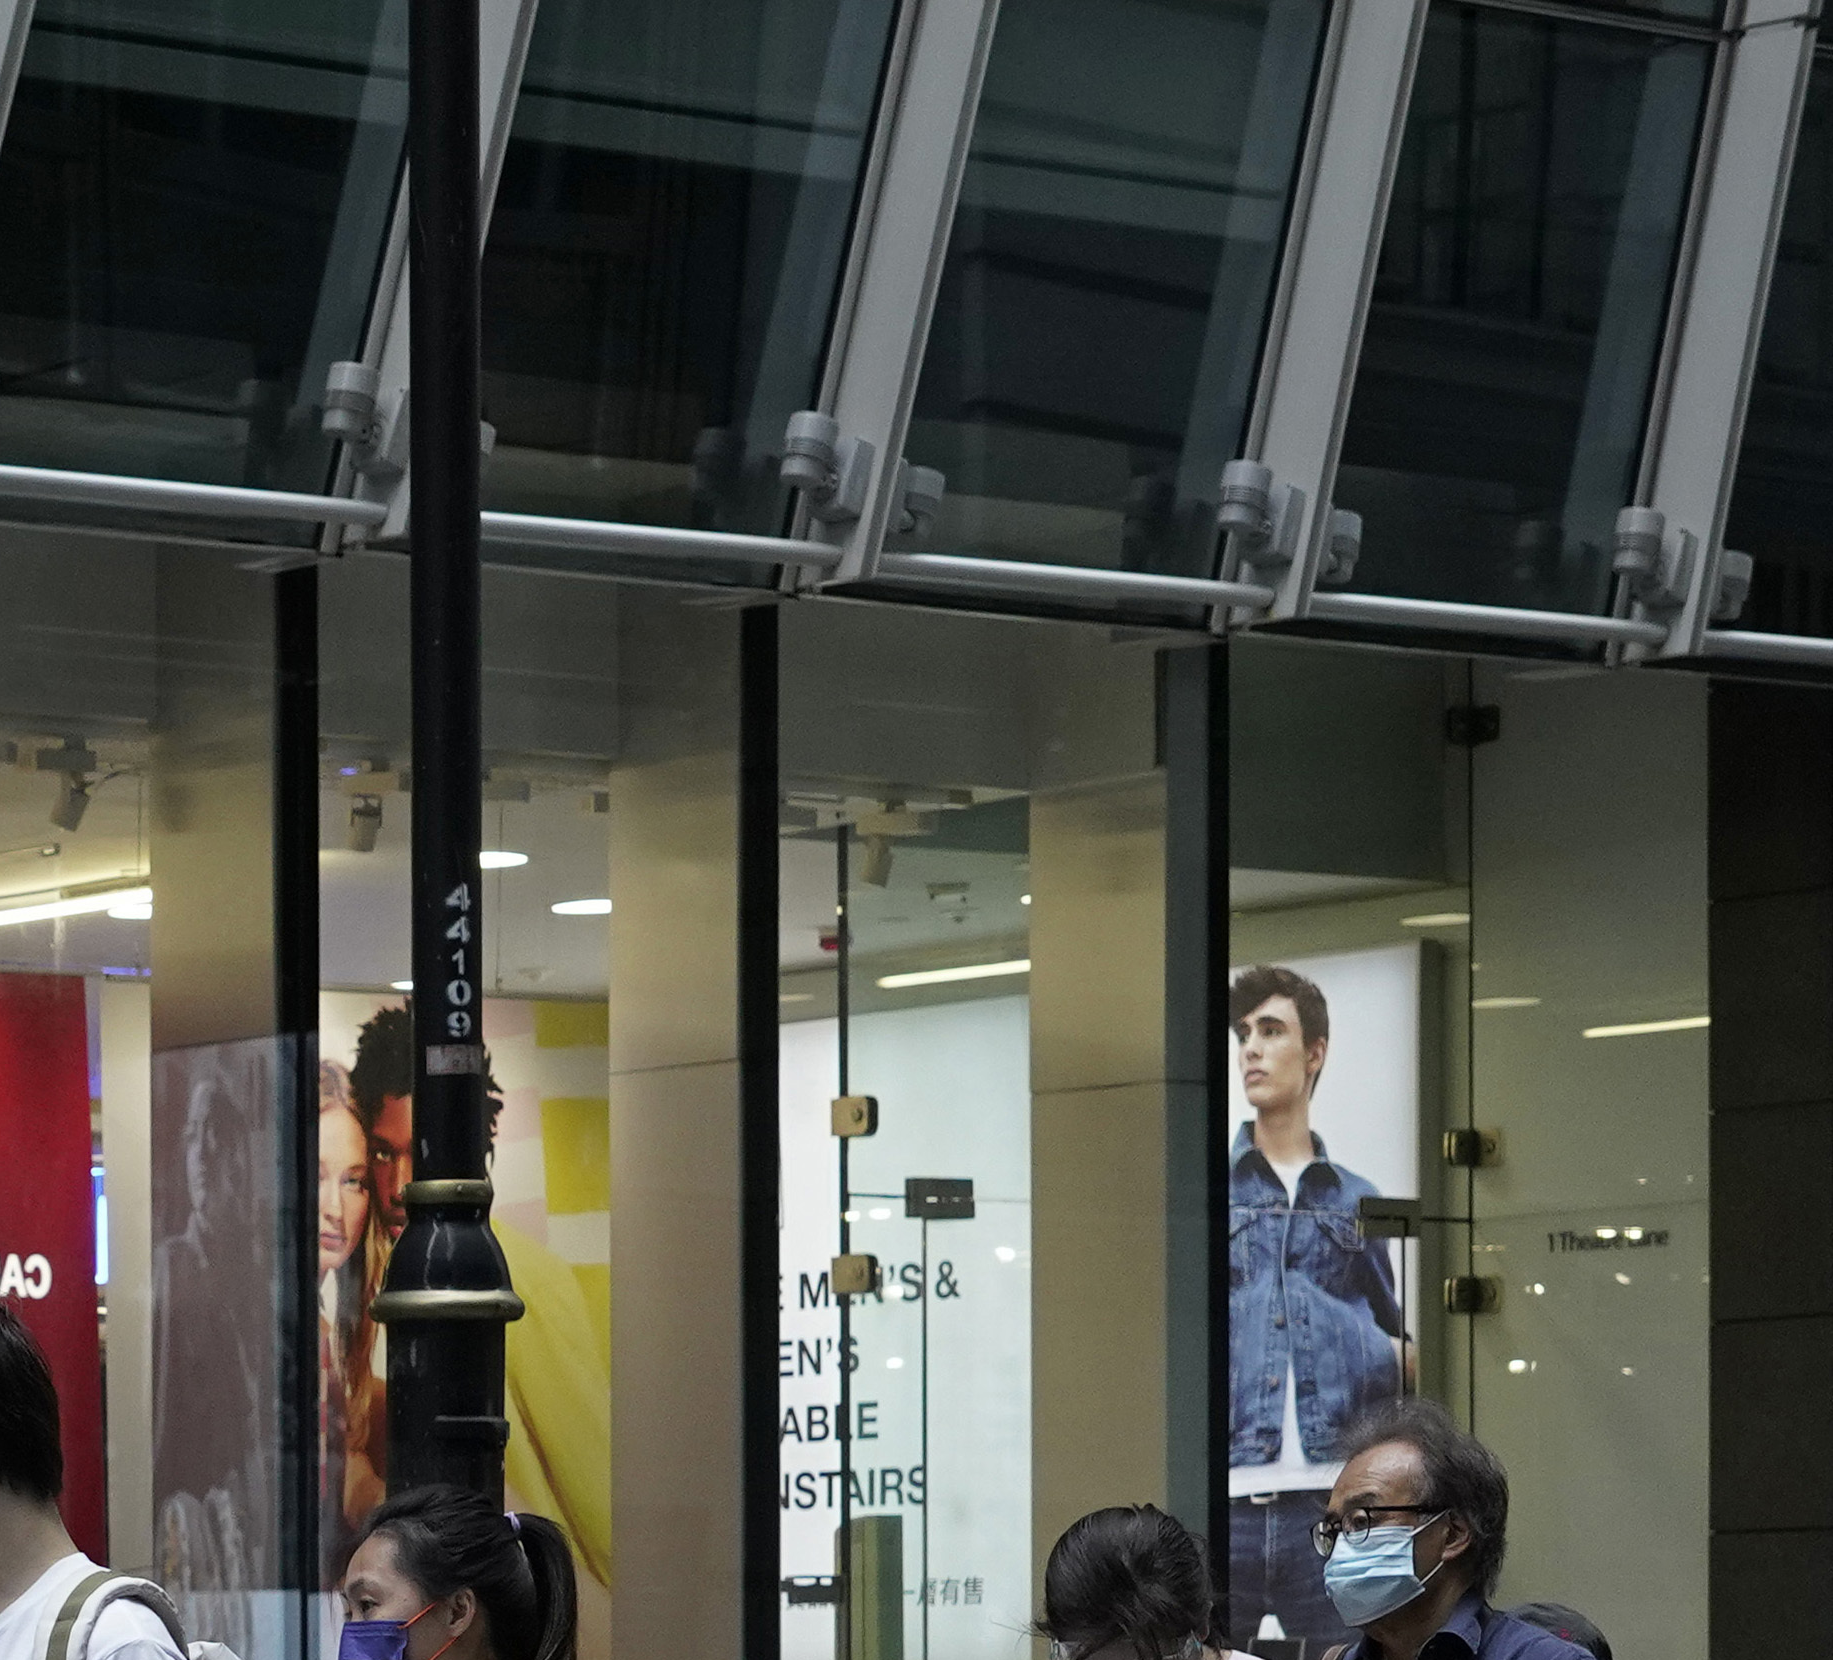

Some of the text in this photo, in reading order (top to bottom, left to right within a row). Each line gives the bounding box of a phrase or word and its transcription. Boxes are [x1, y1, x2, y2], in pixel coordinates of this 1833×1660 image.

[445, 882, 472, 1038] 44109
[799, 1260, 960, 1309] M'S &
